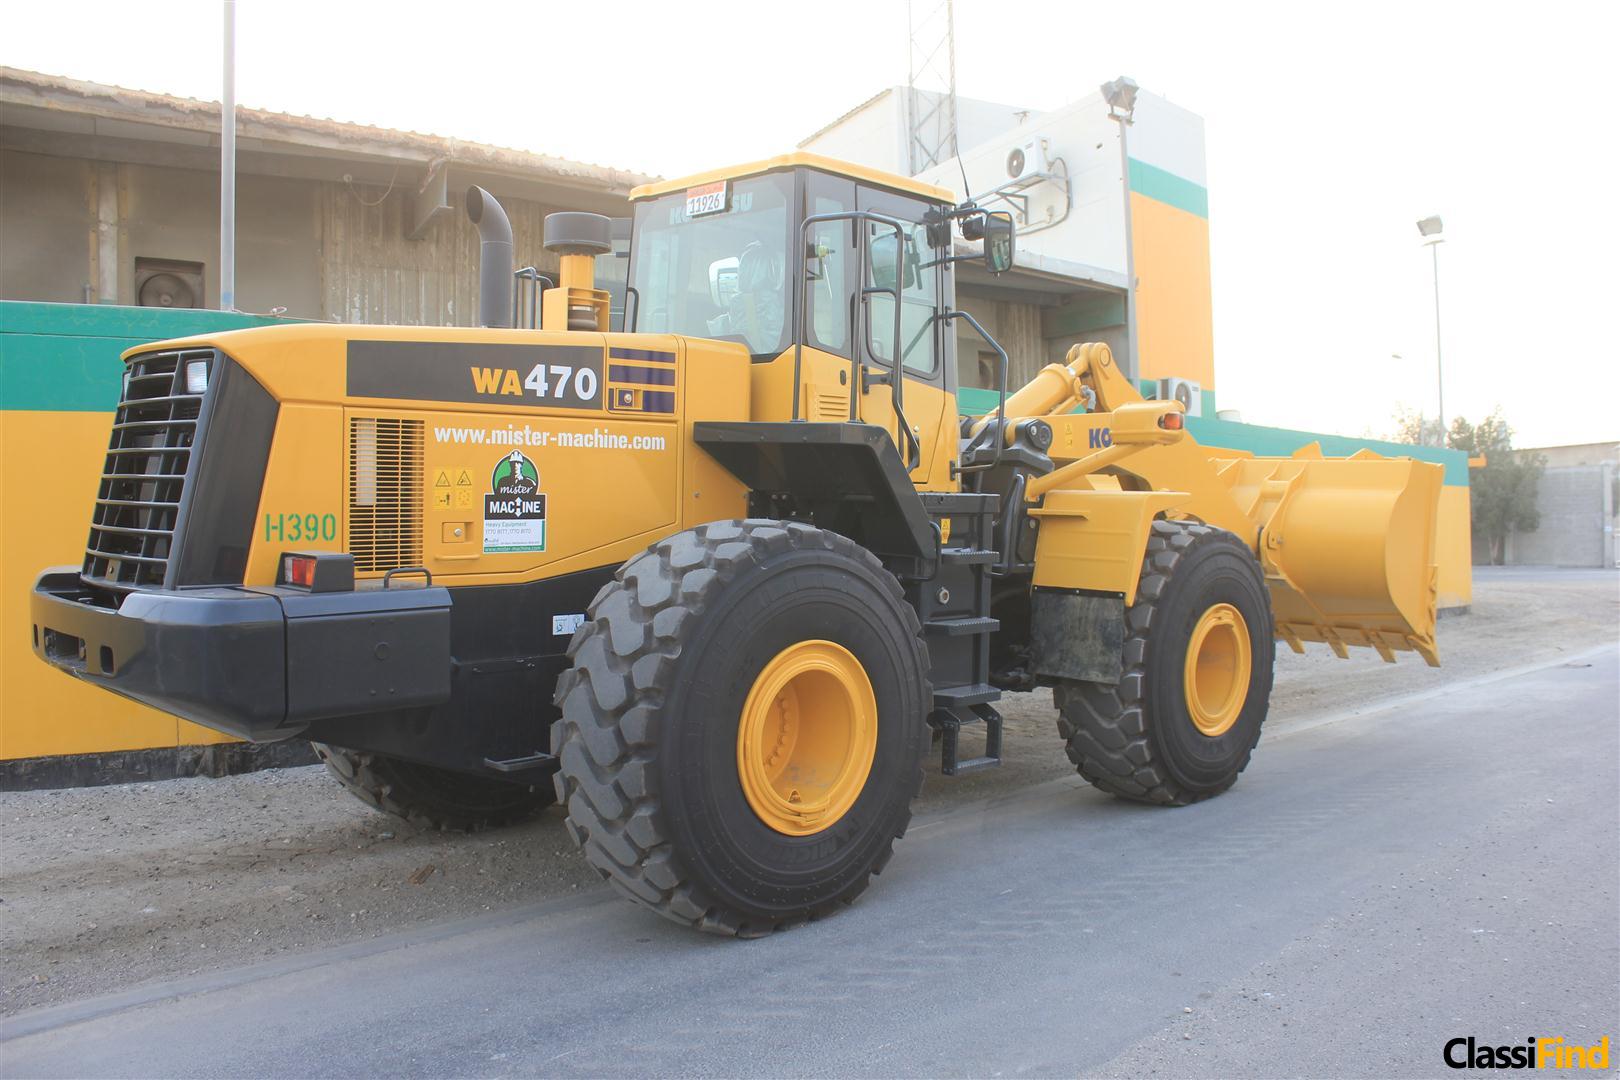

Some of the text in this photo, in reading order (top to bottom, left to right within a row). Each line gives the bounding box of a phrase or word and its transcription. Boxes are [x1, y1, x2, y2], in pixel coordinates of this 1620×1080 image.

[689, 193, 720, 214] 11926
[434, 424, 665, 450] www.mister-machine.com
[500, 484, 533, 494] mister
[265, 513, 336, 542] H390
